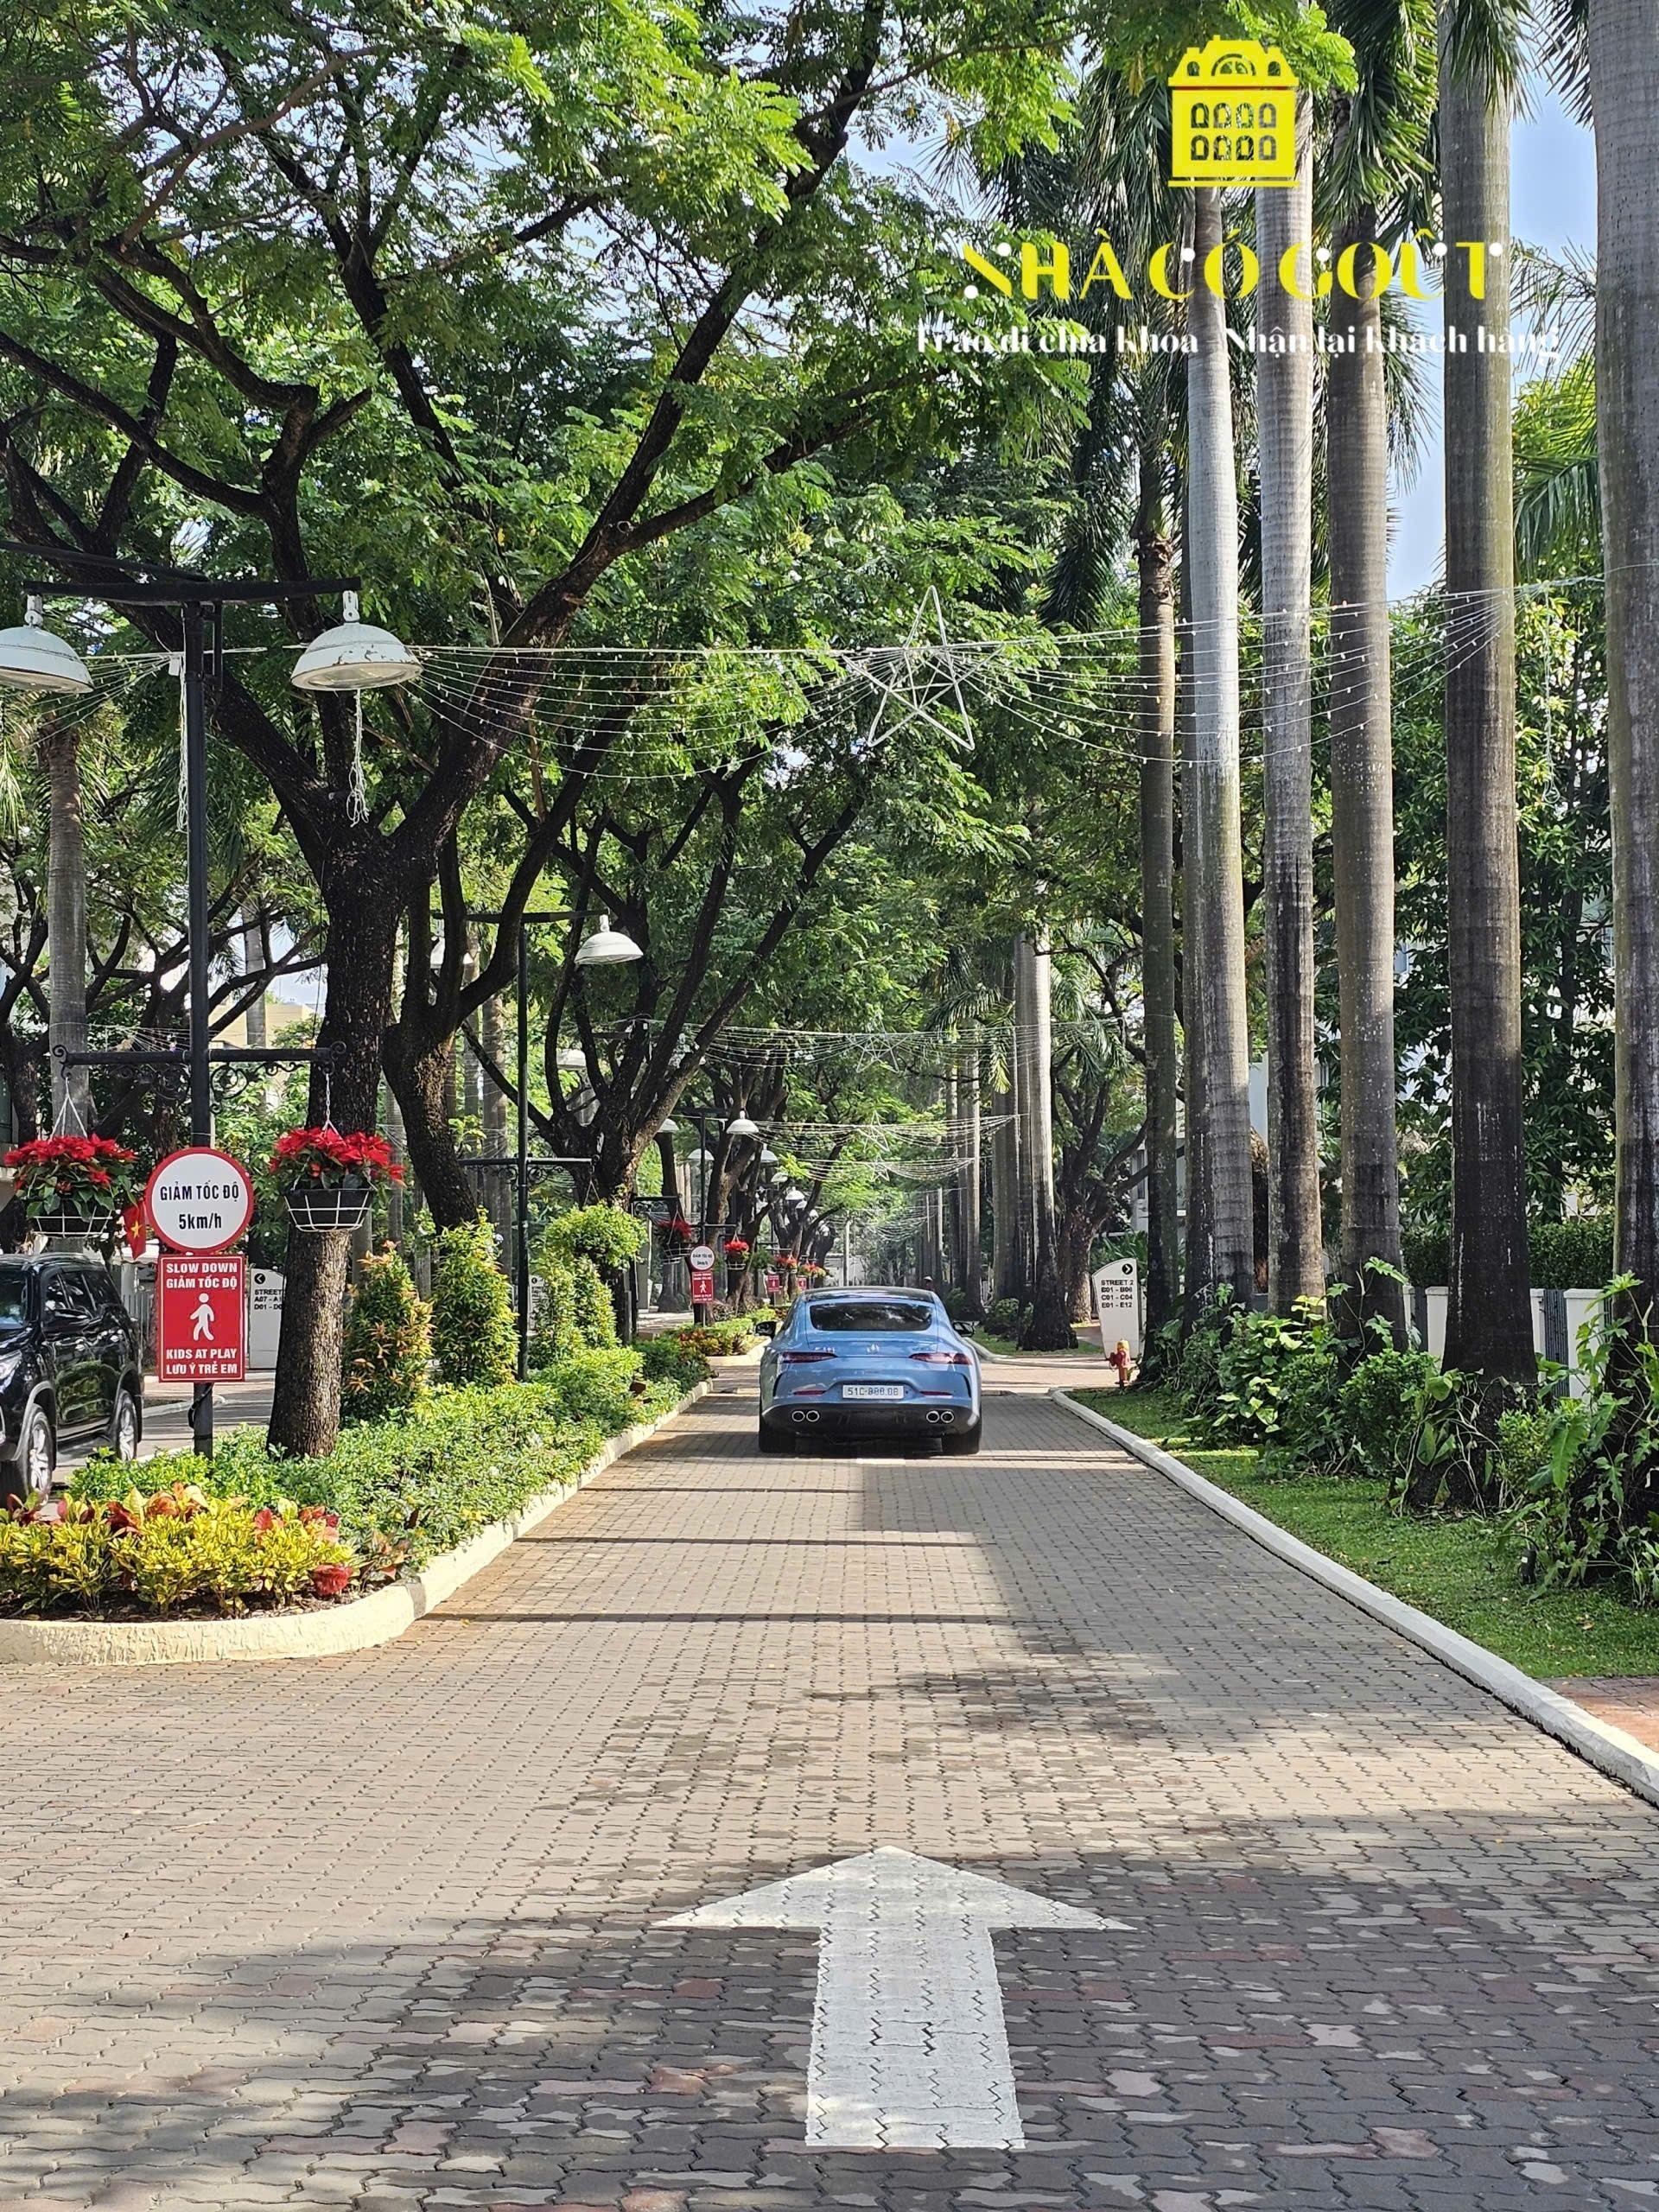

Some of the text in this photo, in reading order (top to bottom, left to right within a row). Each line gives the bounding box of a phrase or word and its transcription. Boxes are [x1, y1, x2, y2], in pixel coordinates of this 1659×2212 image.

[160, 1179, 239, 1202] GIẢM TỐC ĐỘ
[179, 1212, 222, 1230] 5km/h
[166, 1262, 238, 1274] SLOW DOWN
[166, 1274, 238, 1290] GIẢM TỐC ĐỘ
[166, 1348, 237, 1360] KIDS AT PLAY
[189, 1362, 196, 1375] Ý
[198, 1361, 219, 1374] TRẺ
[220, 1363, 238, 1374] EM
